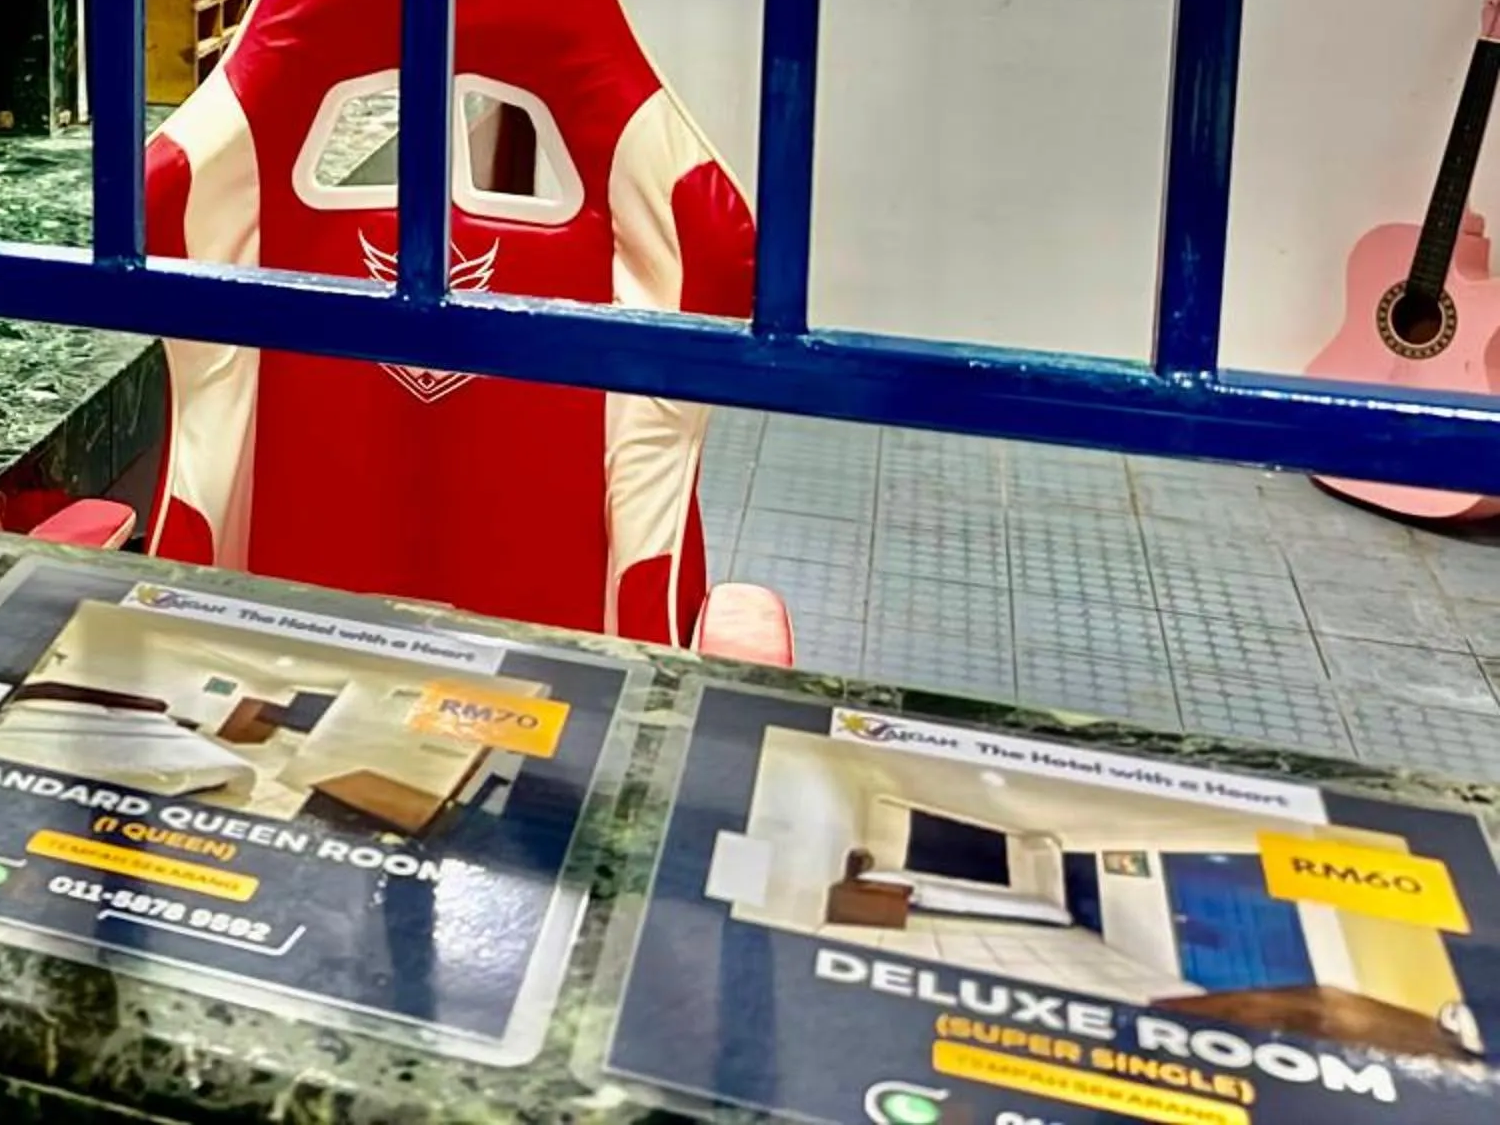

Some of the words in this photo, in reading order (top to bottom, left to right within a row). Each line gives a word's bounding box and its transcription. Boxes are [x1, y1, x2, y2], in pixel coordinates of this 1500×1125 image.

[238, 608, 275, 625] The
[278, 616, 335, 637] Hotel
[339, 627, 387, 646] with
[390, 640, 407, 650] a
[410, 641, 476, 663] Heart
[438, 698, 539, 731] RM70
[976, 741, 1026, 760] The
[1031, 750, 1102, 775] Hotel
[1108, 765, 1173, 788] with
[1179, 779, 1199, 792] a
[1204, 781, 1289, 807] Heart
[93, 816, 119, 833] (1
[121, 822, 238, 862] QUEEN)
[159, 805, 306, 855] QUEEN
[1290, 856, 1424, 896] RM60
[814, 947, 1117, 1042] DELUXE
[1136, 1014, 1397, 1103] ROOM
[935, 1013, 1082, 1063] (SUPER
[1090, 1047, 1256, 1105] SINGLE)
